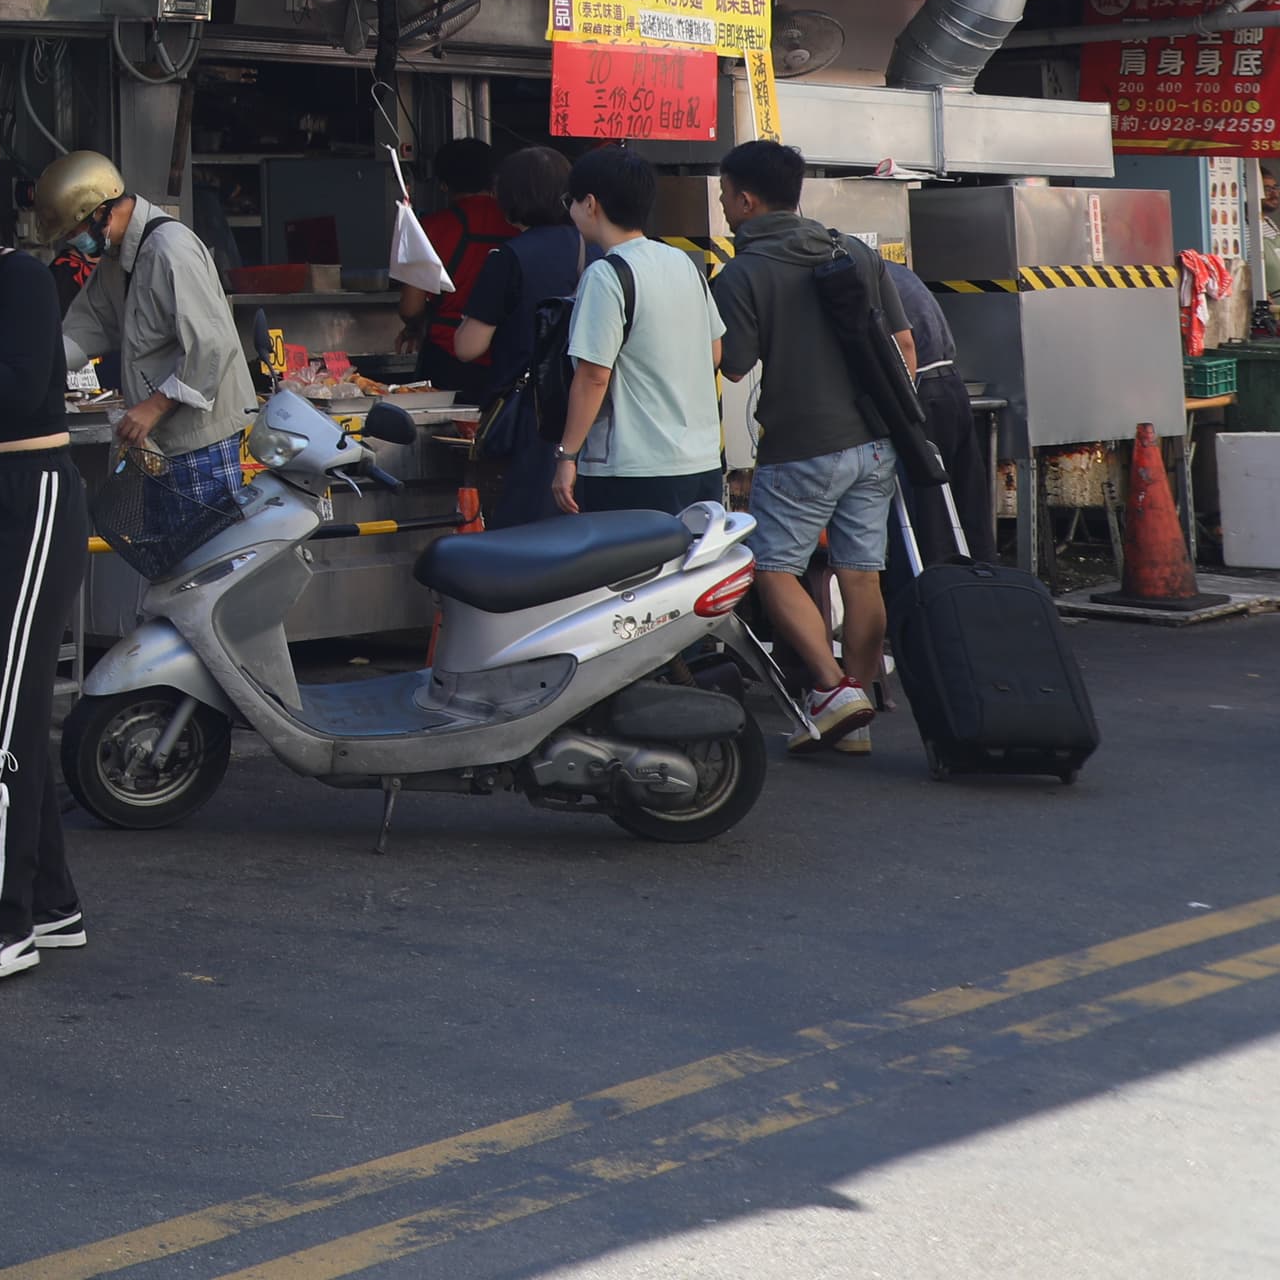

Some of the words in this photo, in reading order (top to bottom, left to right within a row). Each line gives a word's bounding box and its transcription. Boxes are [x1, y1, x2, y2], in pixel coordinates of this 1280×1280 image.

[753, 53, 779, 143] 滿額送
[1118, 82, 1145, 93] 200
[1156, 82, 1183, 93] 400
[1194, 82, 1221, 94] 700
[1234, 82, 1261, 94] 600
